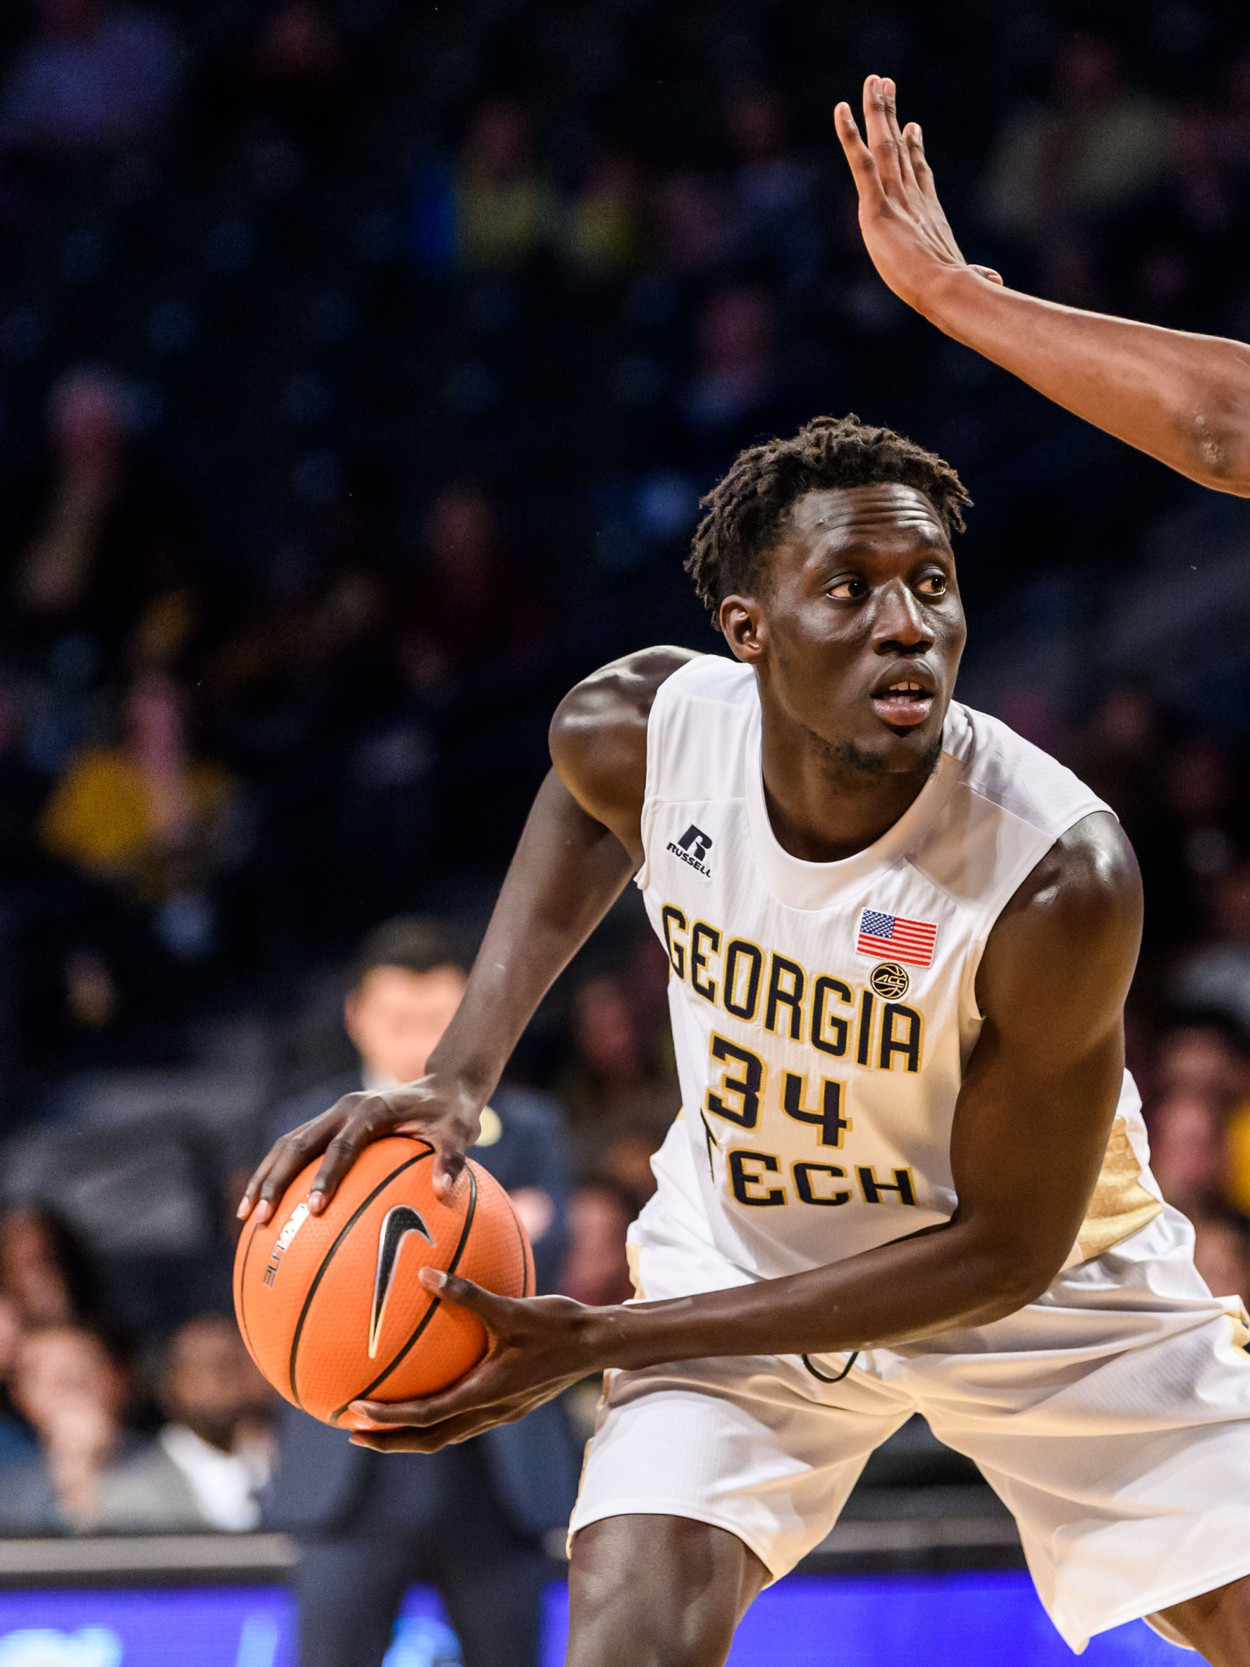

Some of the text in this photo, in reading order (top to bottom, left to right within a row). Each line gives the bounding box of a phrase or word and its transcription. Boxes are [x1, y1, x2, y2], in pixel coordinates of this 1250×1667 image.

[666, 842, 711, 878] RUSSELL
[661, 903, 926, 1074] GEORGIA
[875, 974, 907, 986] ACC
[706, 1029, 853, 1149] 34
